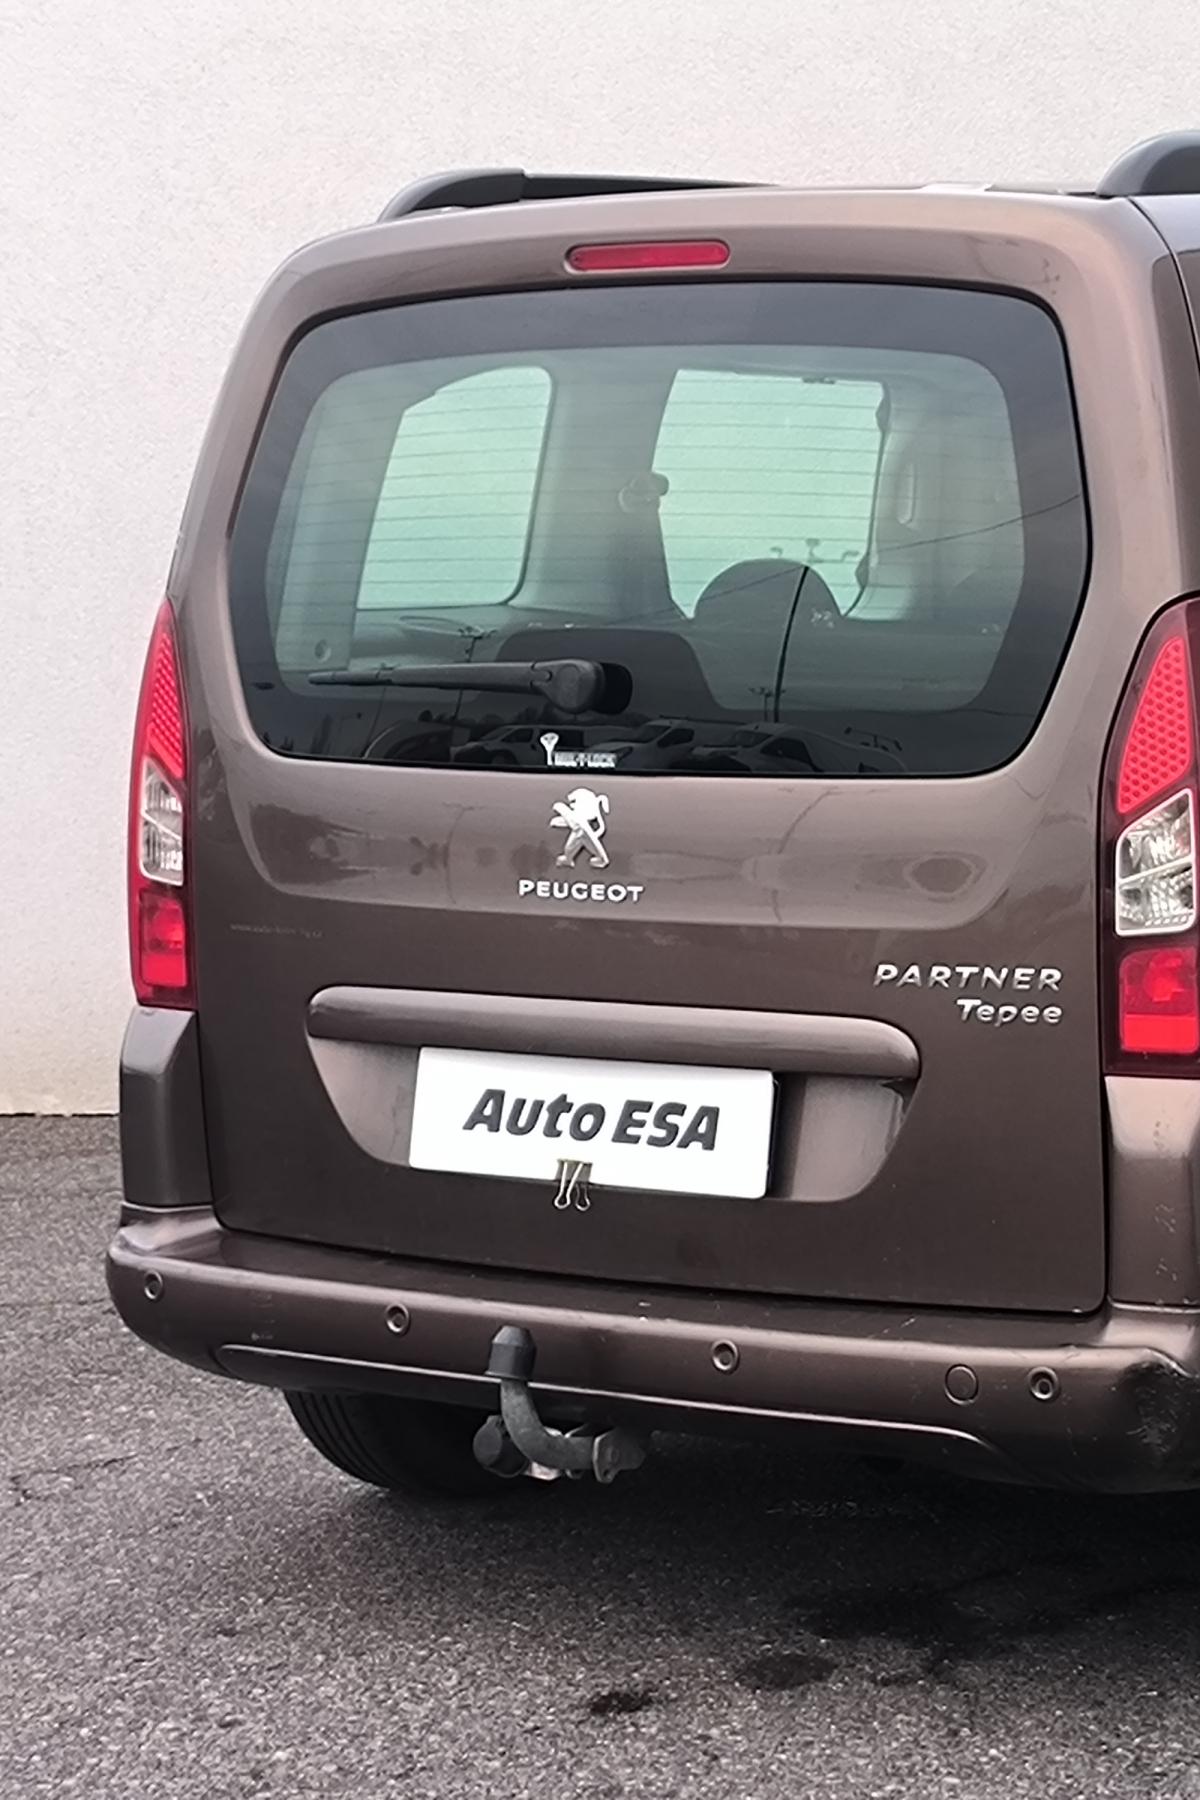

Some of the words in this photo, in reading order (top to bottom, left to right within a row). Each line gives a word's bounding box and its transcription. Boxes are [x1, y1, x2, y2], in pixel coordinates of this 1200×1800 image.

[518, 879, 644, 902] PEUGEOT
[873, 963, 1062, 991] PARTNER
[956, 998, 1063, 1026] Tepee
[462, 1088, 606, 1141] Auto
[611, 1099, 720, 1151] ESA
